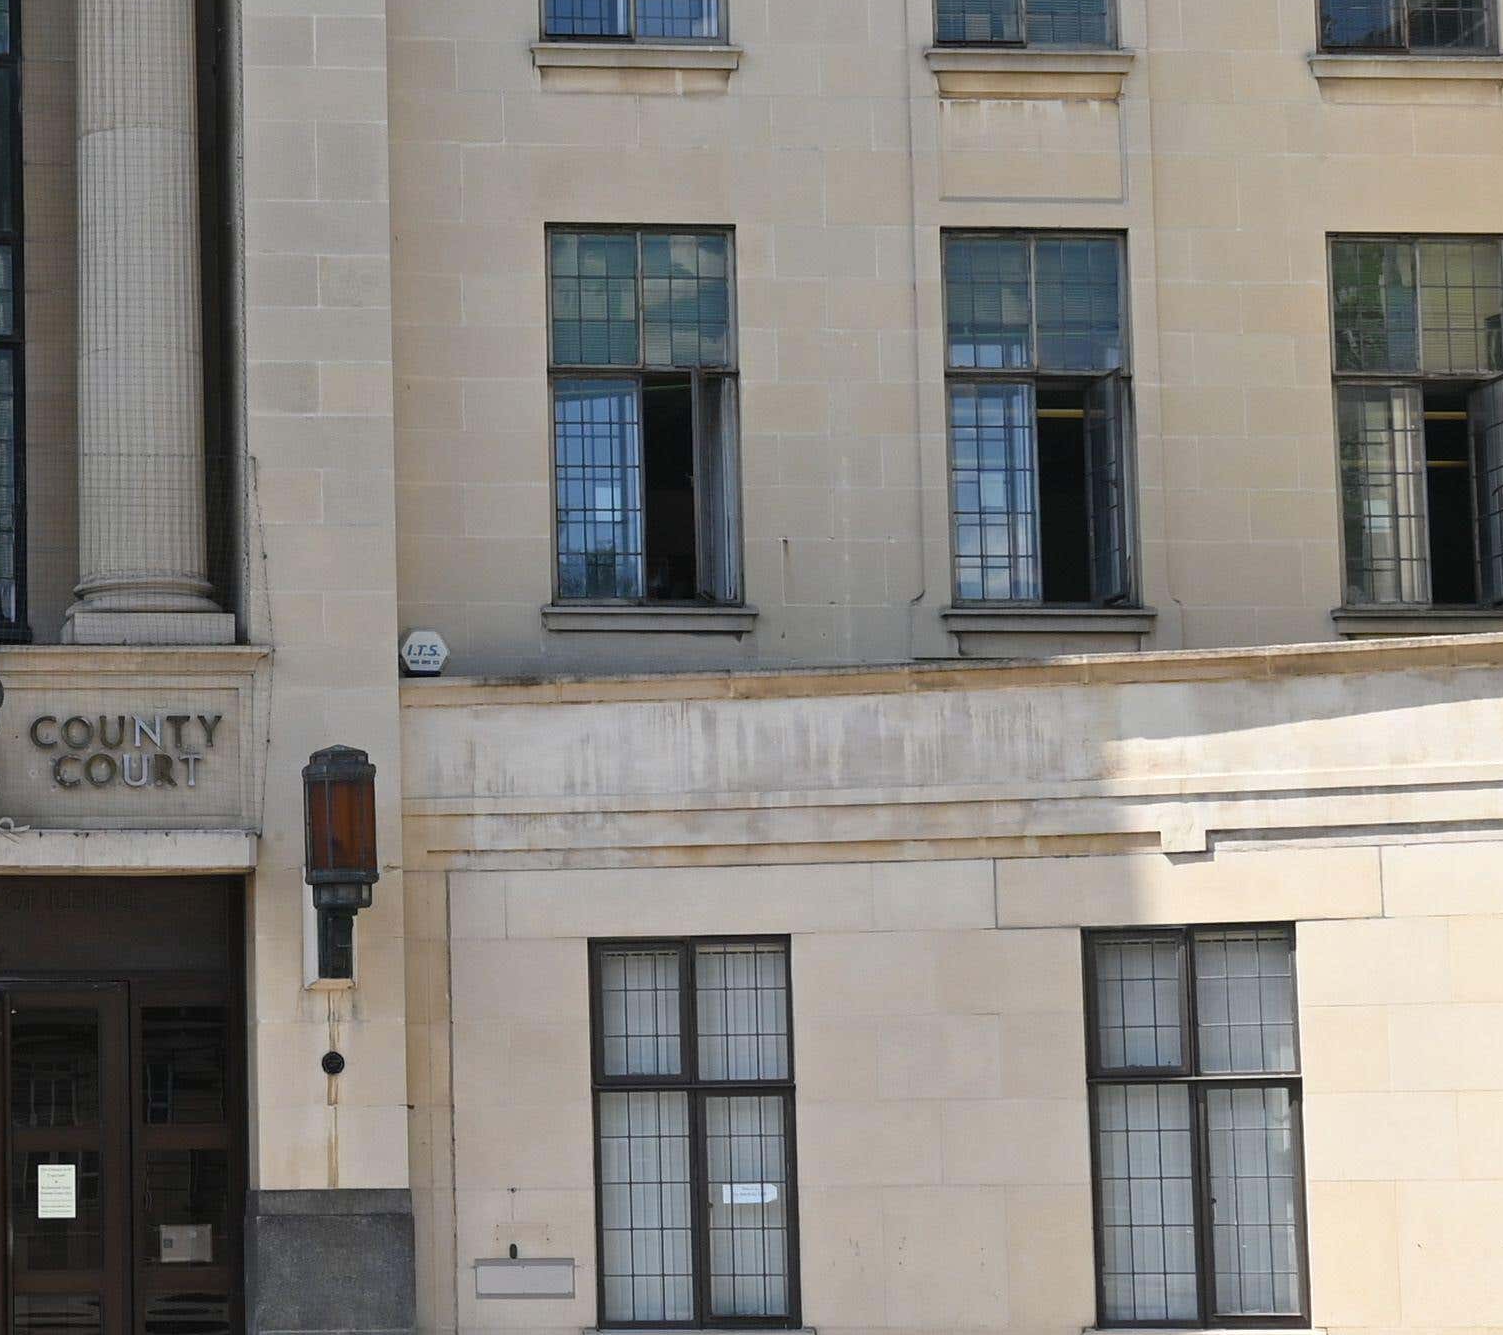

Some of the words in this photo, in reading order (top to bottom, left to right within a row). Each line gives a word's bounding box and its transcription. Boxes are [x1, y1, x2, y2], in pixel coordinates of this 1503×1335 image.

[407, 644, 441, 656] I.T.S.
[30, 714, 223, 752] COUNTY
[53, 752, 204, 787] COURT
